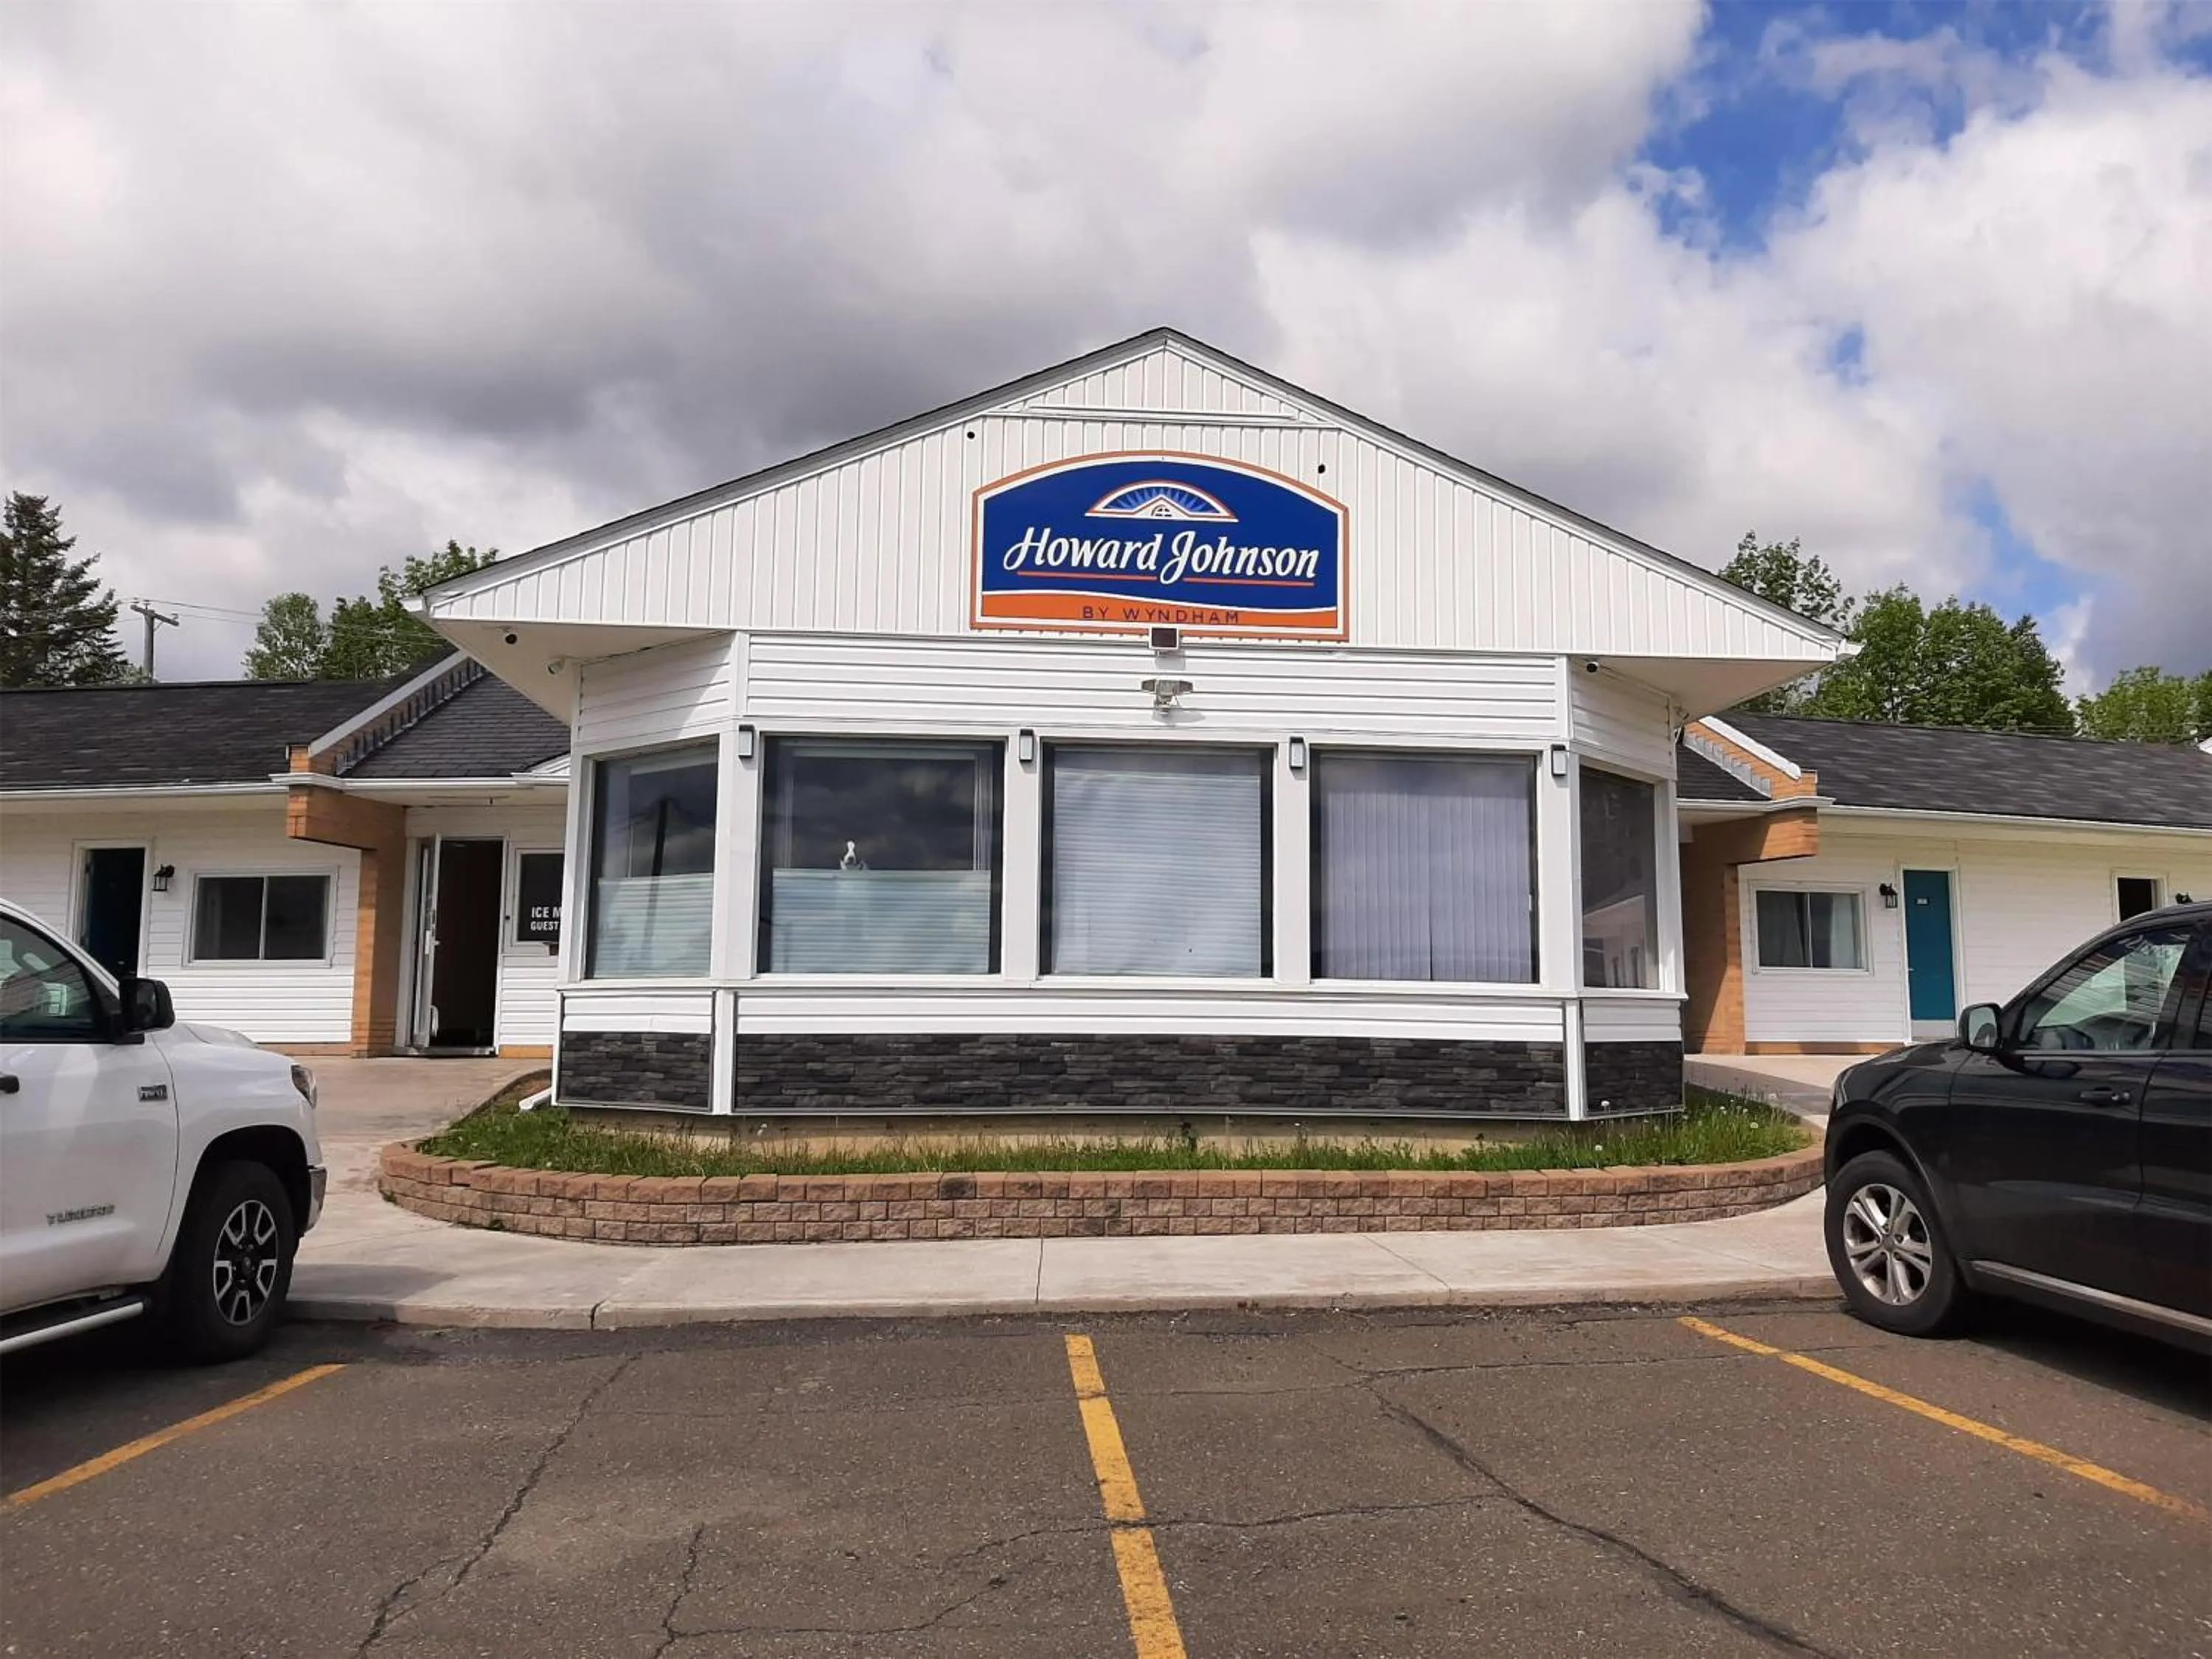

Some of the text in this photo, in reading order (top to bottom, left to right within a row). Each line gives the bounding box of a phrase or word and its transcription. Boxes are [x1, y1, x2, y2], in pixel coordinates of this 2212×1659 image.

[1003, 526, 1319, 585] Howard Johnson
[1082, 605, 1239, 624] BY WYNDHAM
[531, 906, 549, 918] ICE
[530, 921, 559, 931] GUEST
